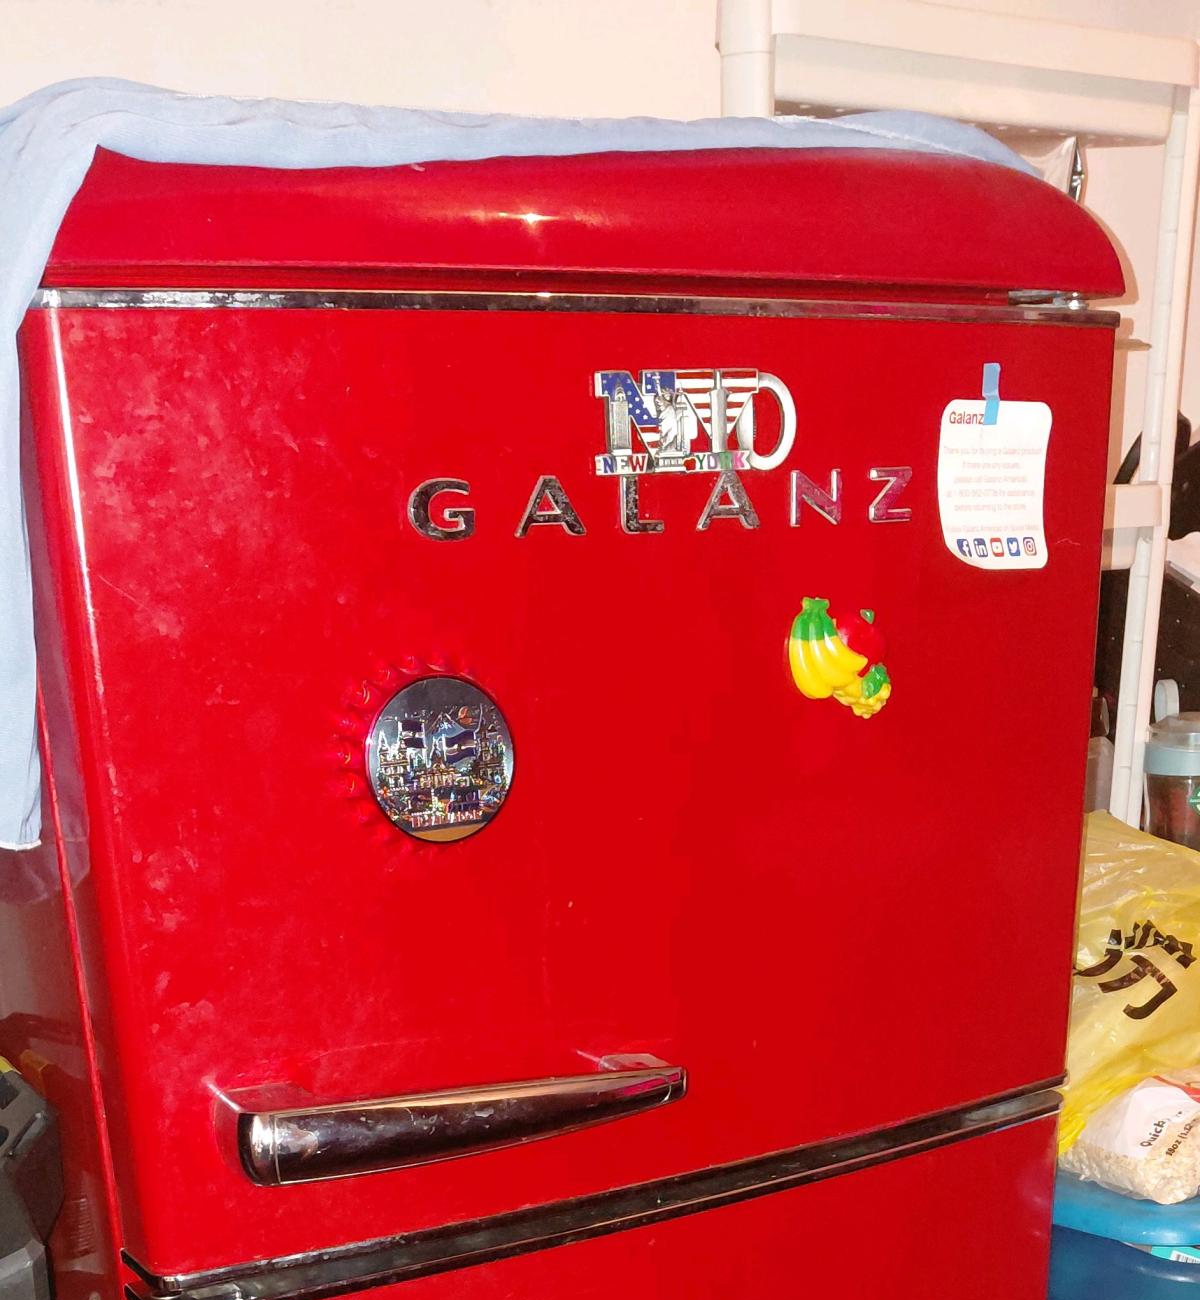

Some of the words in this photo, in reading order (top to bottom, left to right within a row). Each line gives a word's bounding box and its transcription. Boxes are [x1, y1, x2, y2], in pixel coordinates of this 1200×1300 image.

[949, 411, 984, 425] Galanz
[602, 456, 646, 474] NEW
[697, 452, 746, 470] YORK
[407, 467, 914, 542] GALANZ
[1140, 1120, 1166, 1147] Quick
